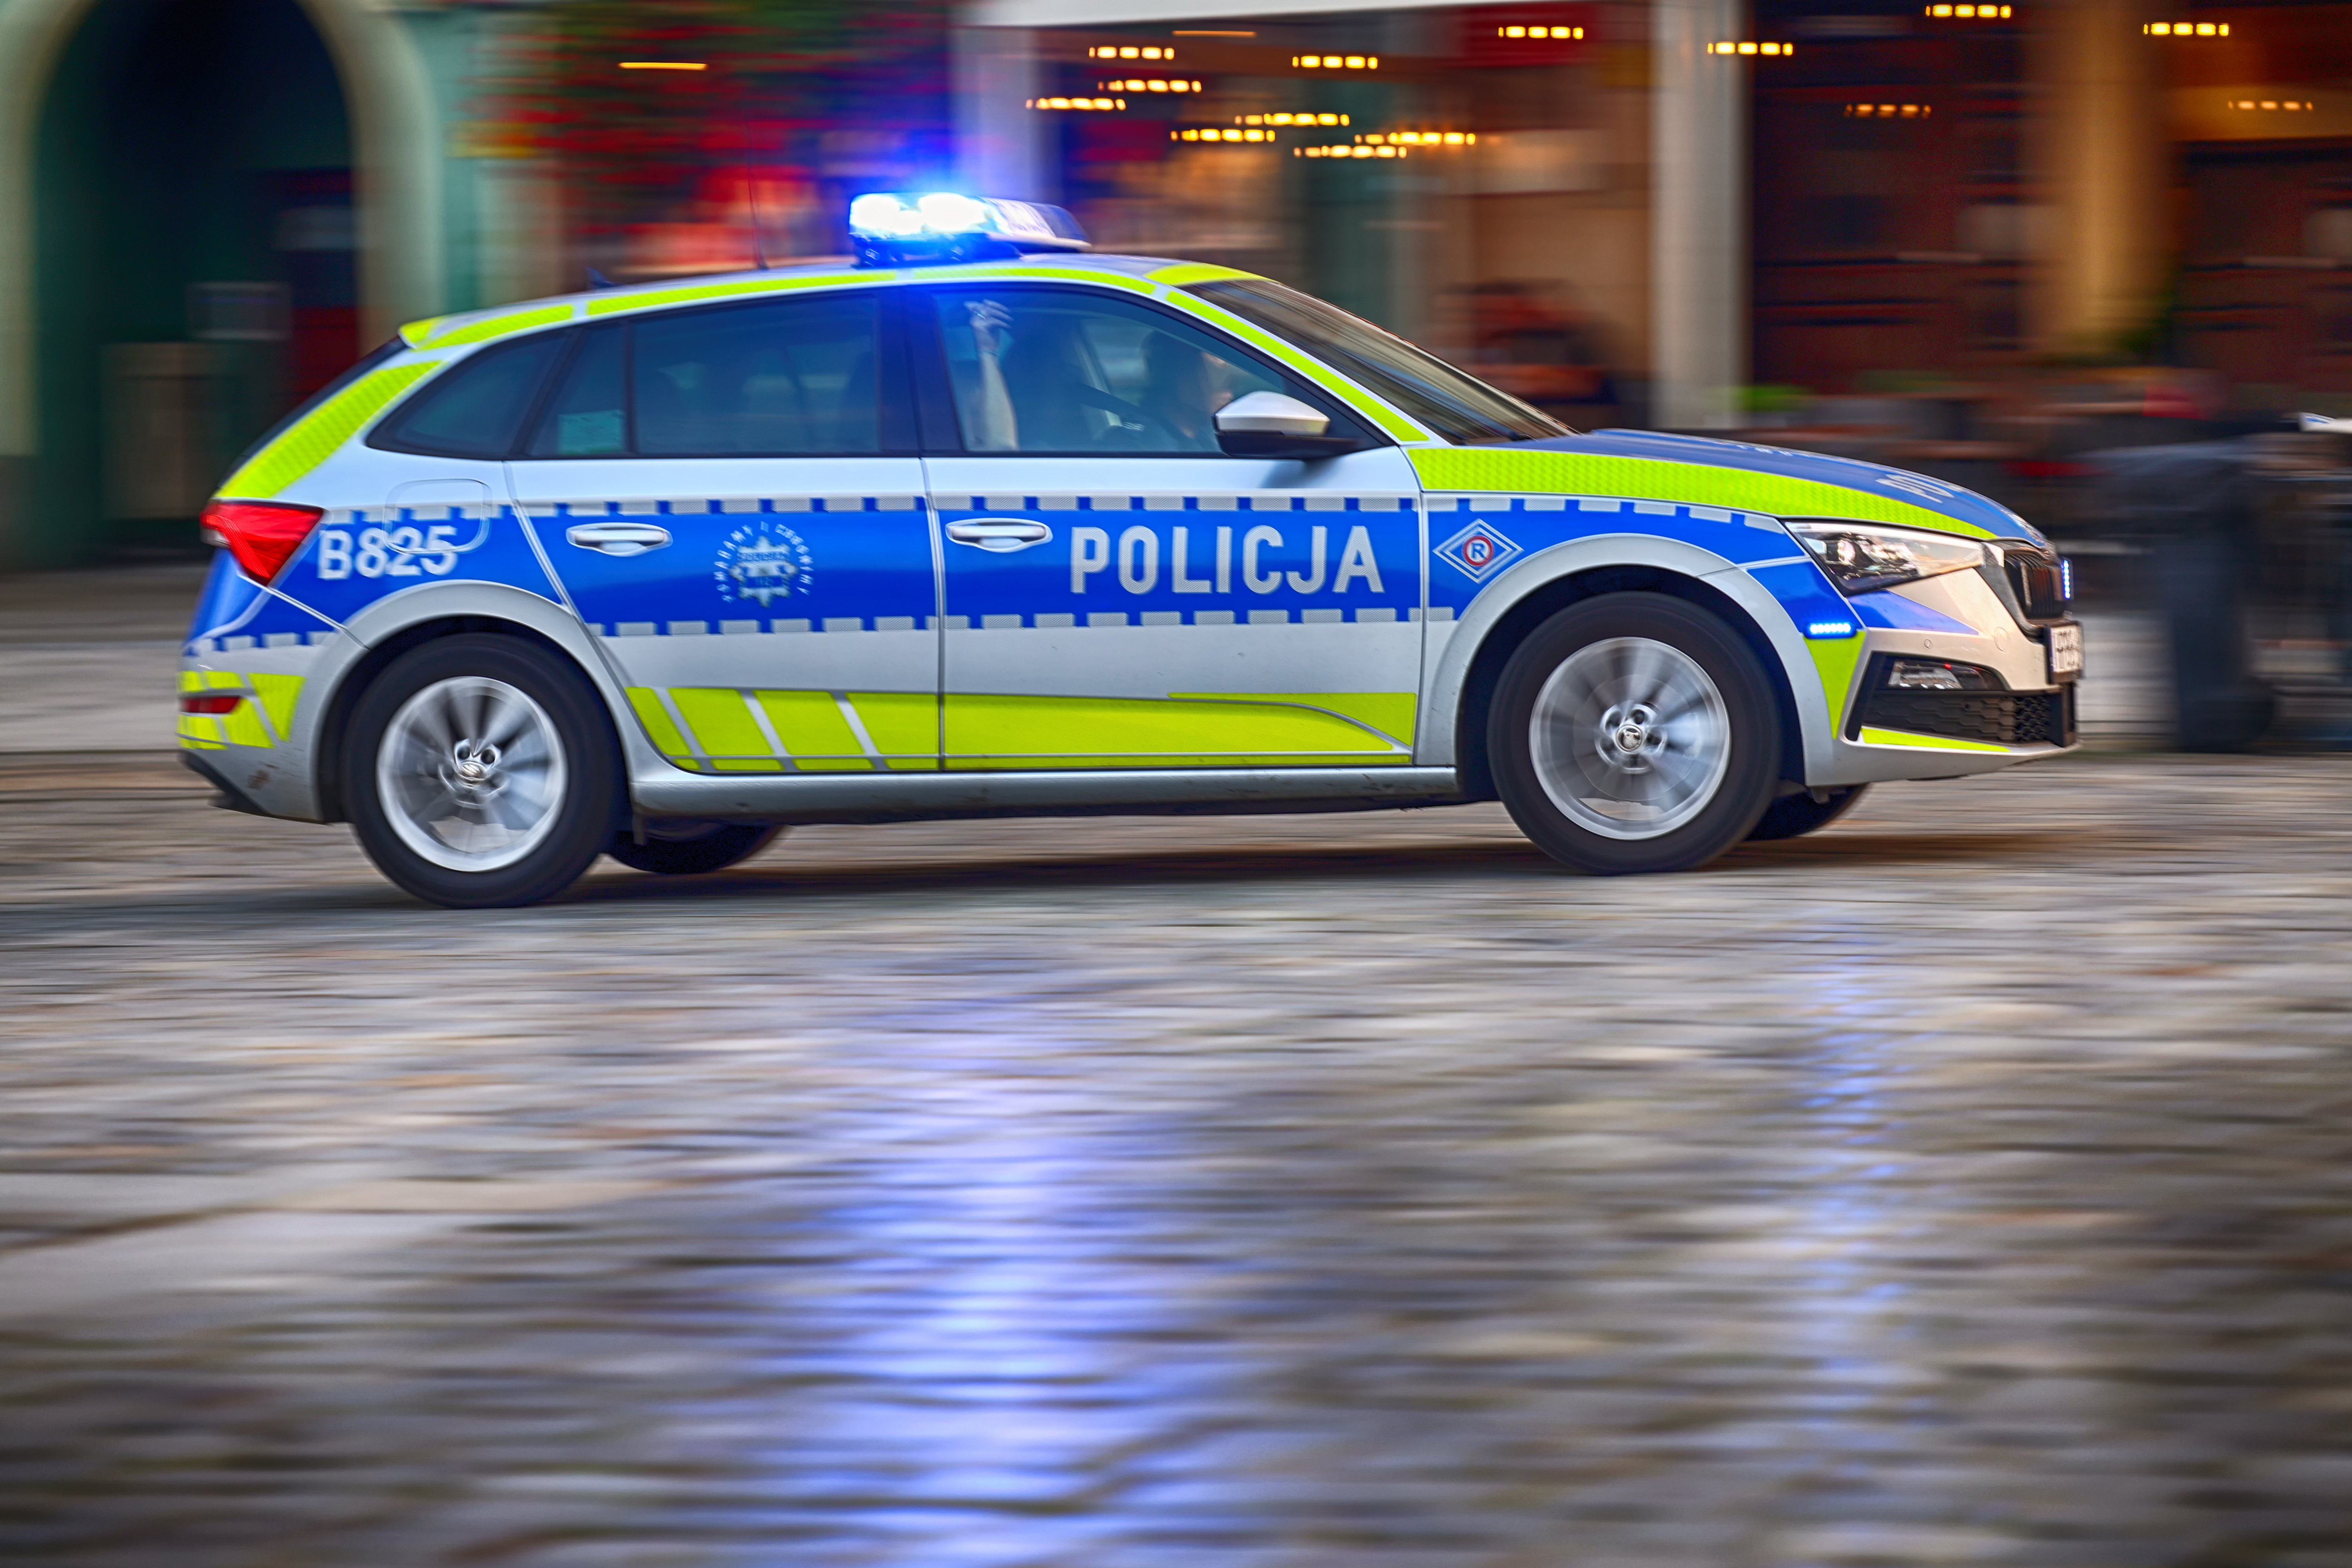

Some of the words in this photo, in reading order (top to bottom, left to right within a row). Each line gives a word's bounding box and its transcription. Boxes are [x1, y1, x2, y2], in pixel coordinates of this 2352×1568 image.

[318, 525, 458, 580] B825
[1070, 525, 1385, 595] POLICJA
[1472, 543, 1485, 559] R
